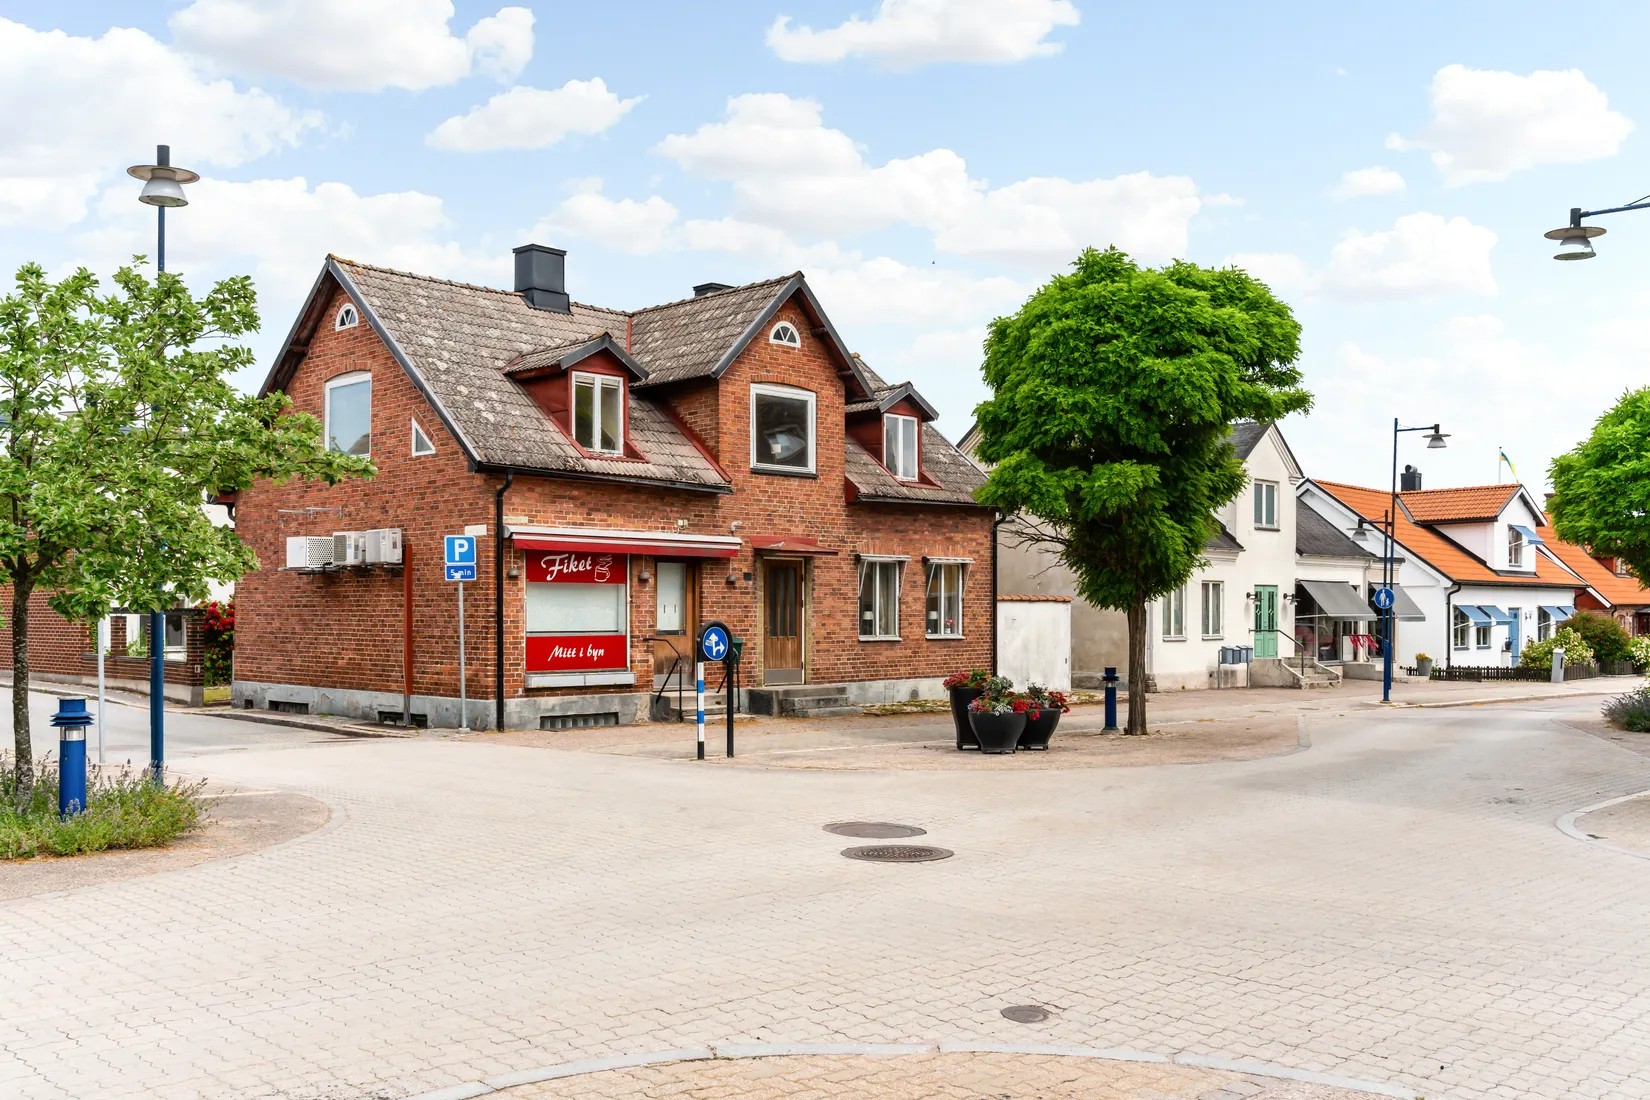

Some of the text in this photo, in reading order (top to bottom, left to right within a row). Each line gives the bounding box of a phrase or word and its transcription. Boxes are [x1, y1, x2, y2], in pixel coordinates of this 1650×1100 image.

[454, 539, 469, 561] P
[541, 553, 593, 581] Fiket
[548, 644, 604, 662] Mitt i byn
